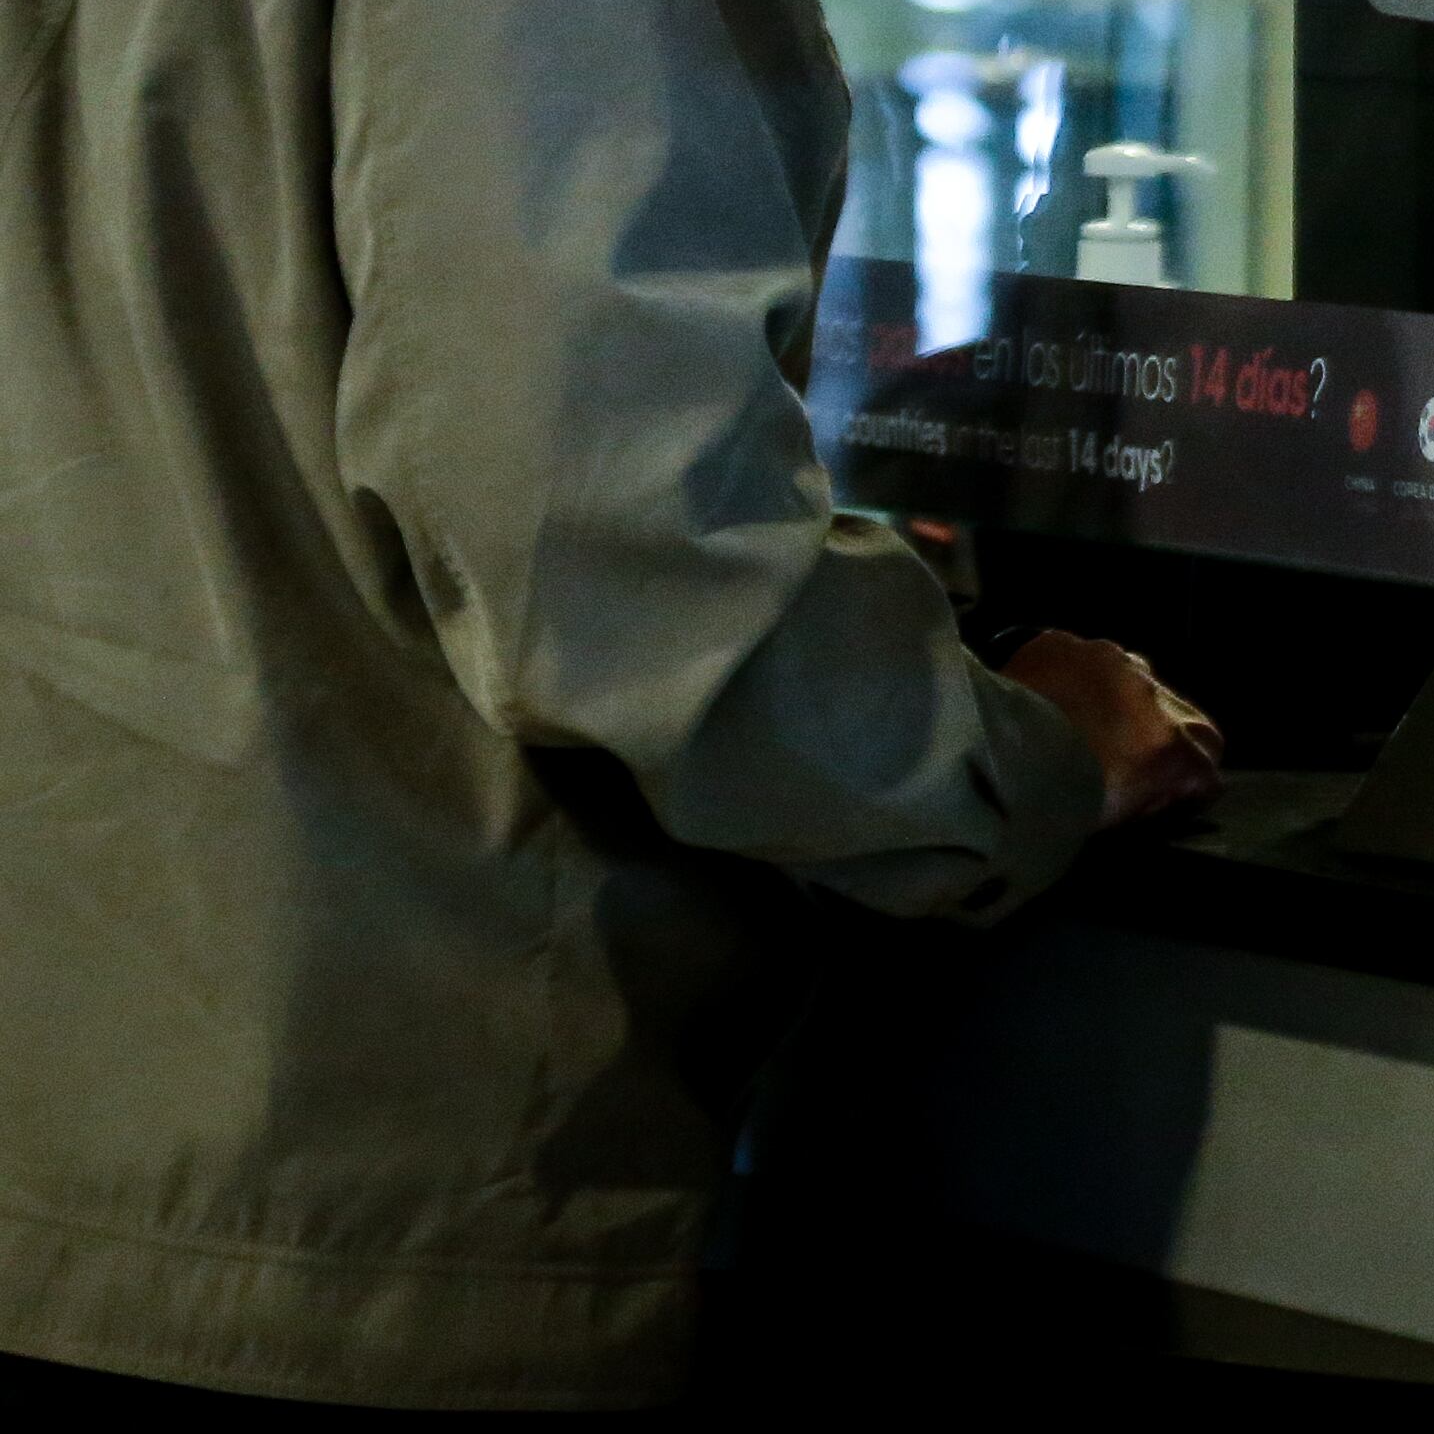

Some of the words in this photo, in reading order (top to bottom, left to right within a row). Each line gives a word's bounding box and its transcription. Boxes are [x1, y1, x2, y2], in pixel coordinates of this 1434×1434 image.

[1069, 328, 1177, 404] últimos
[1189, 343, 1229, 406] 14
[1236, 347, 1327, 419] días?
[1068, 427, 1099, 475] 14
[1103, 434, 1175, 493] days?
